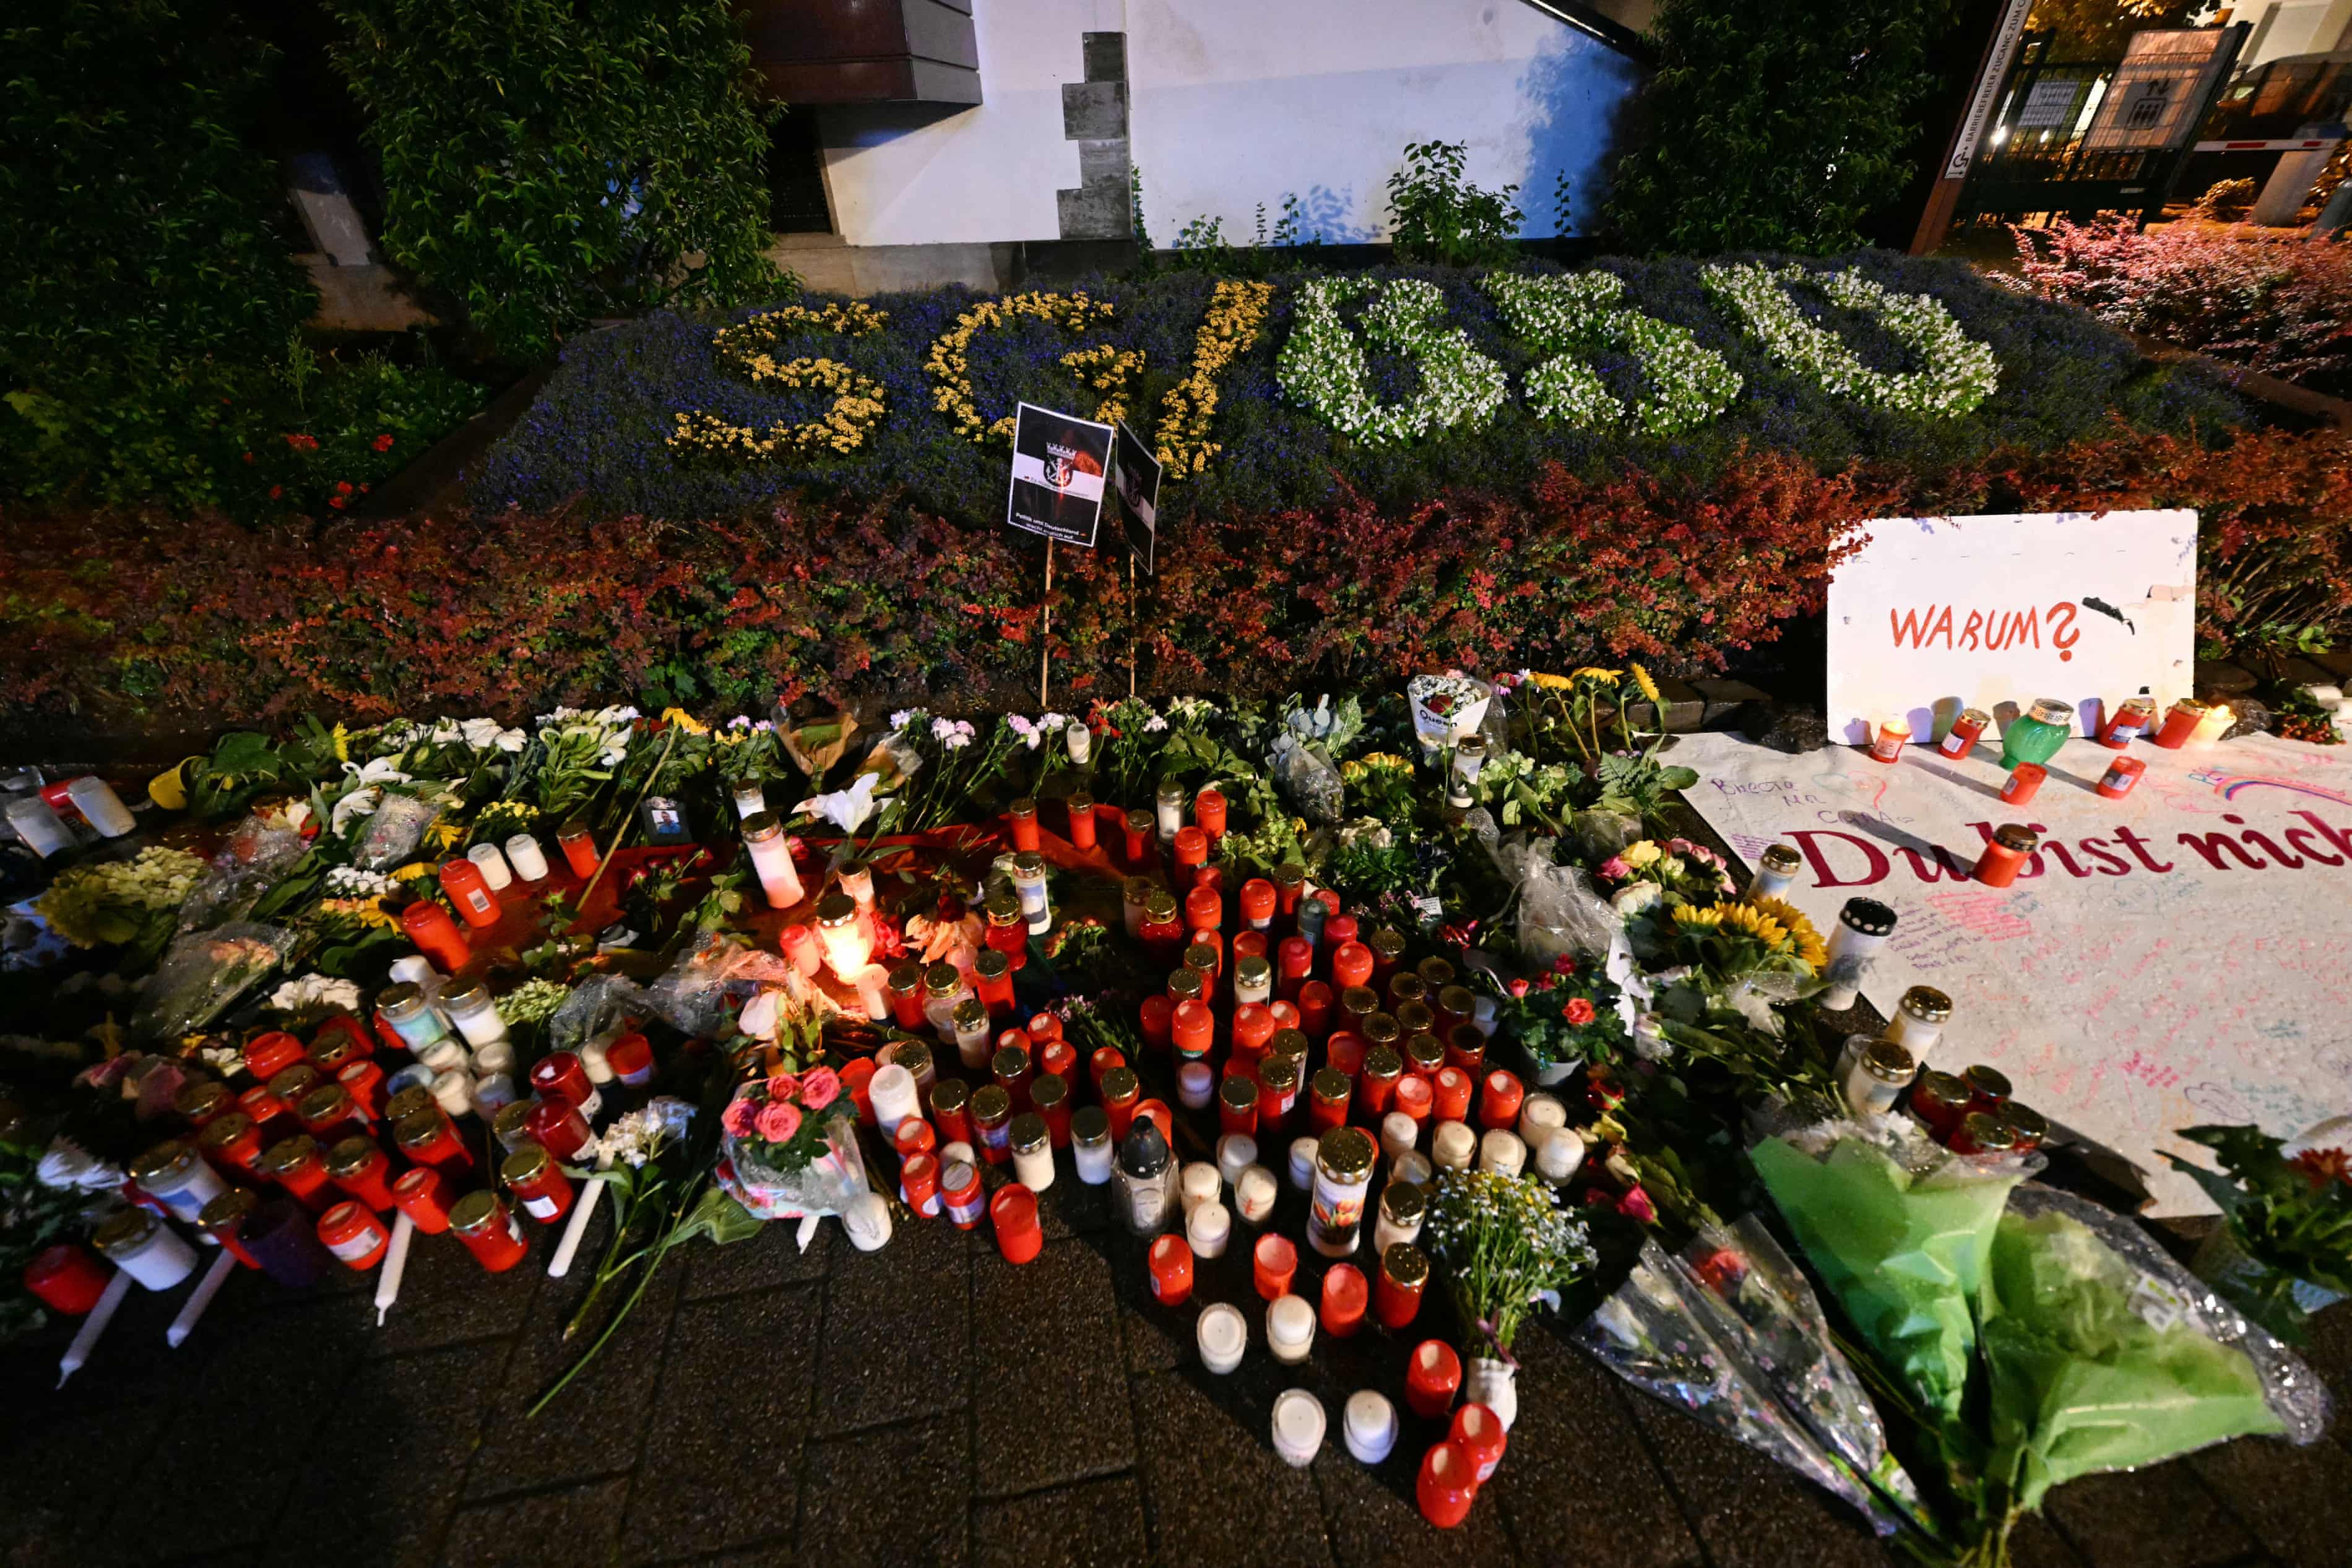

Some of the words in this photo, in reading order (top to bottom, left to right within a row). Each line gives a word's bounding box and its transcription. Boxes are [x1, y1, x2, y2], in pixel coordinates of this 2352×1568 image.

[1992, 34, 2013, 73] ZUGANG
[2010, 10, 2022, 31] ZUM
[1276, 260, 2003, 448] 650
[1890, 601, 2080, 661] WARUM?
[1780, 830, 1976, 889] Du
